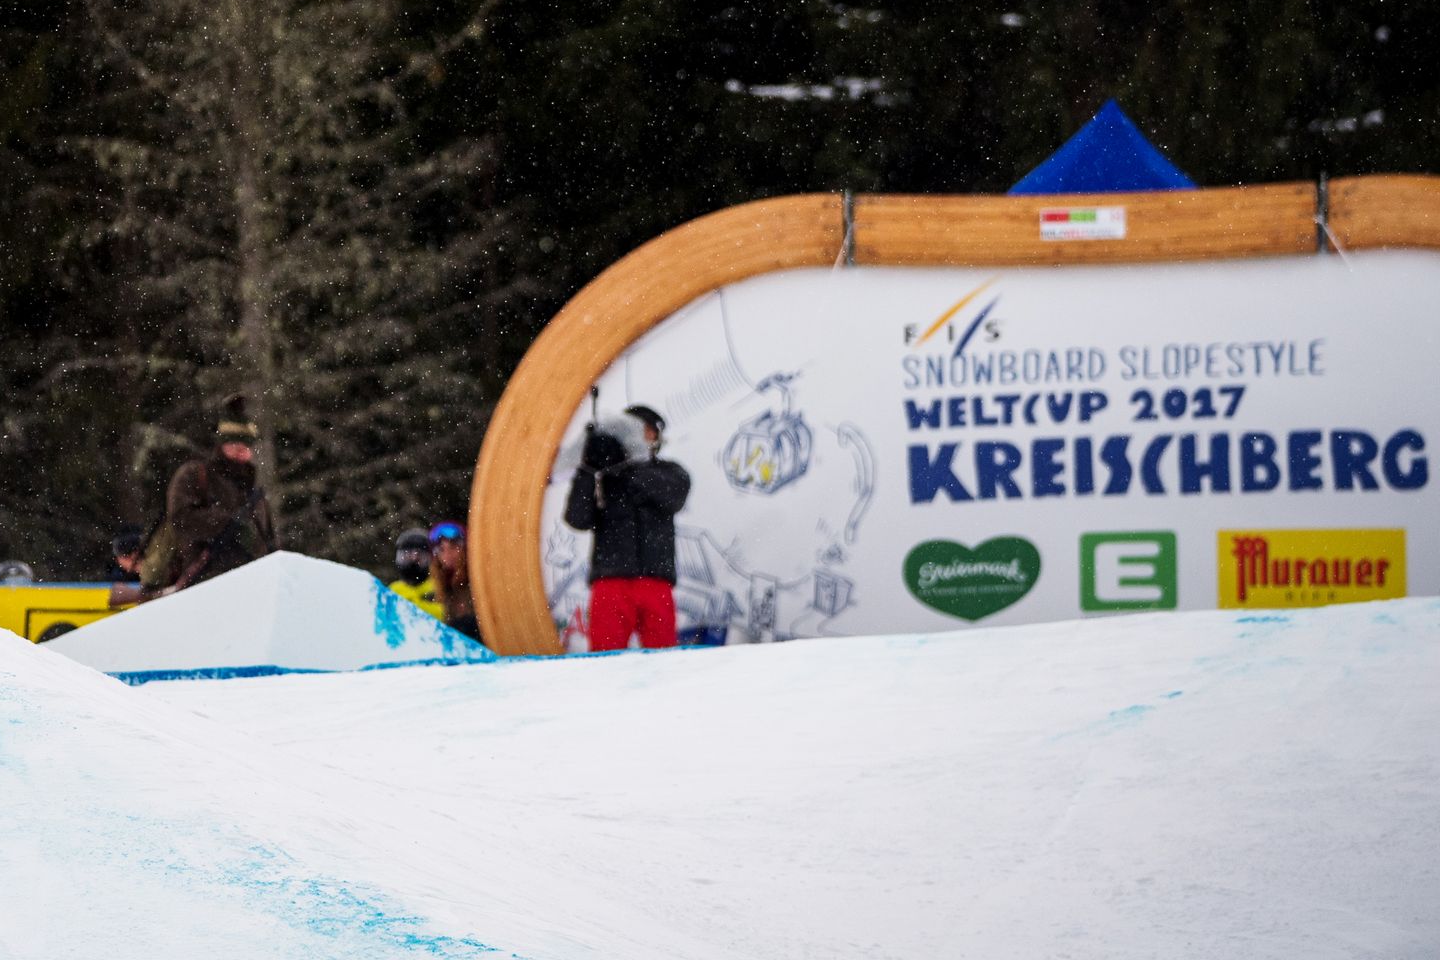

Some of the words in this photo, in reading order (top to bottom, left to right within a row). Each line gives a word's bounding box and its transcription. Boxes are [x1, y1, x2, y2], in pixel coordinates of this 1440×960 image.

[902, 346, 1107, 389] SNOWBOARD
[1119, 338, 1327, 381] SLOPESTYLE
[904, 390, 1110, 430] WELTCUP
[1129, 383, 1246, 422] 2017
[907, 427, 1429, 505] KREISCHBERG
[1231, 536, 1390, 604] Murauer
